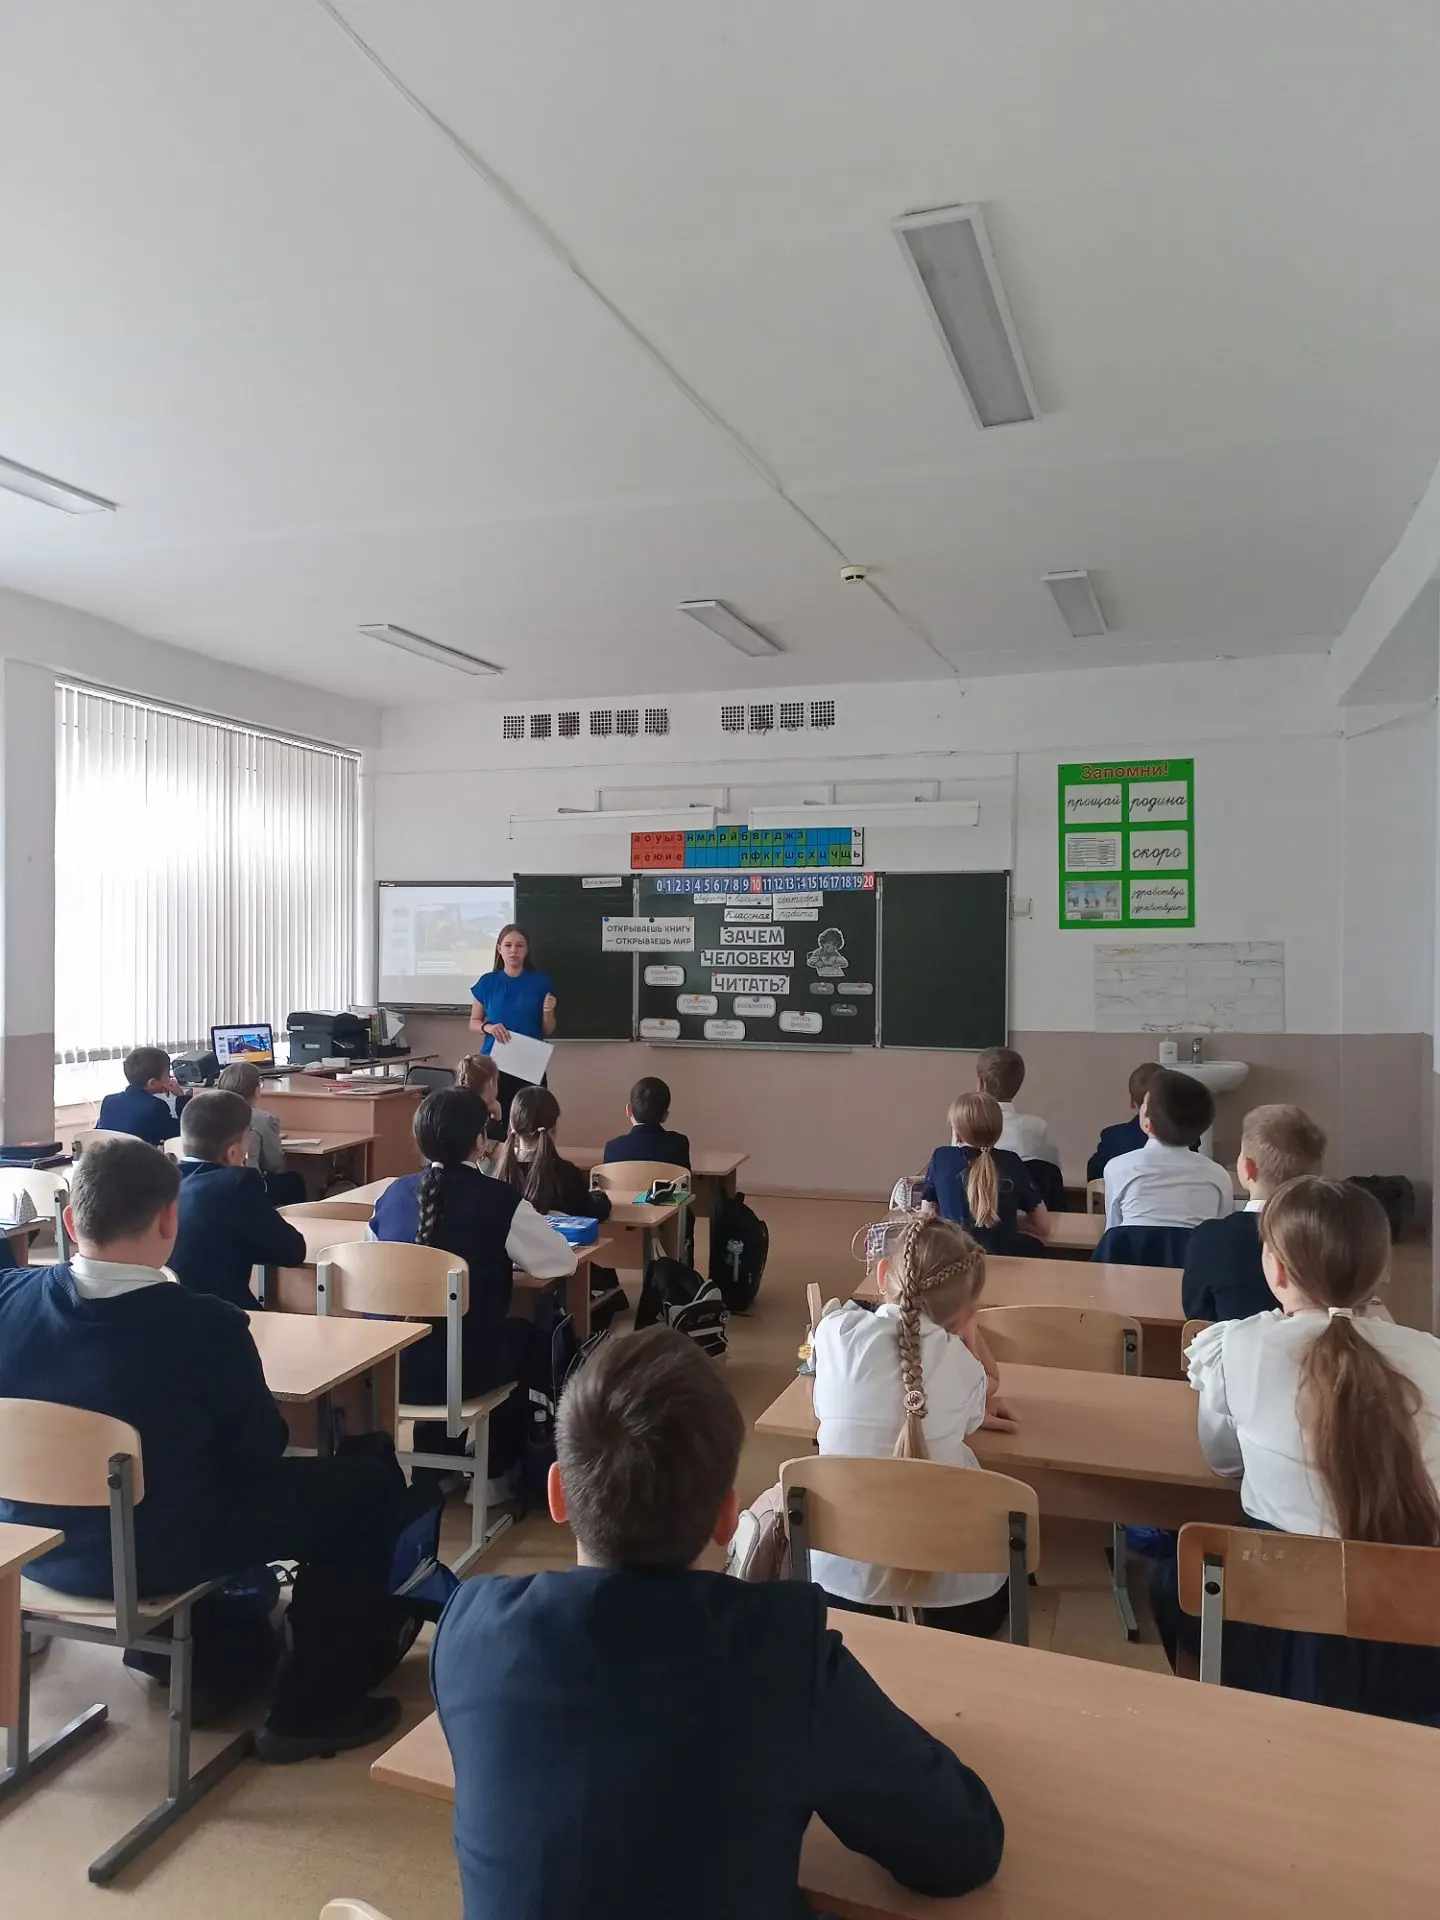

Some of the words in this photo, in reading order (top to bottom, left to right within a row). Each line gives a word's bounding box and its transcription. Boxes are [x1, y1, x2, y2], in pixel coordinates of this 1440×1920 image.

[1081, 761, 1169, 780] Запомни!
[1067, 796, 1121, 812] прощай
[1129, 796, 1186, 812] родина
[1132, 847, 1183, 866] скоро
[656, 880, 662, 891] 0
[666, 880, 671, 891] 1
[675, 880, 681, 891] 2
[685, 880, 691, 891] 3
[694, 880, 701, 891] 4
[704, 880, 710, 891] 5
[713, 880, 720, 891] 6
[723, 879, 730, 891] 7
[733, 879, 739, 891] 8
[743, 879, 749, 890] 9
[752, 879, 760, 890] 10
[763, 879, 771, 890] 11
[774, 878, 783, 890] 12
[785, 878, 794, 889] 13
[797, 877, 806, 889] 14
[808, 877, 817, 889] 15
[820, 876, 829, 888] 16
[831, 876, 839, 888] 17
[841, 876, 851, 888] 18
[853, 876, 862, 888] 19
[863, 875, 874, 888] 20
[607, 925, 663, 933] ОТКРЫВАЕШЬ
[665, 925, 690, 933] КНИГУ
[724, 929, 783, 944] ЗАЧЕМ
[703, 951, 791, 966] ЧЕЛОВЕКУ
[715, 977, 786, 992] ЧИТАТЬ?
